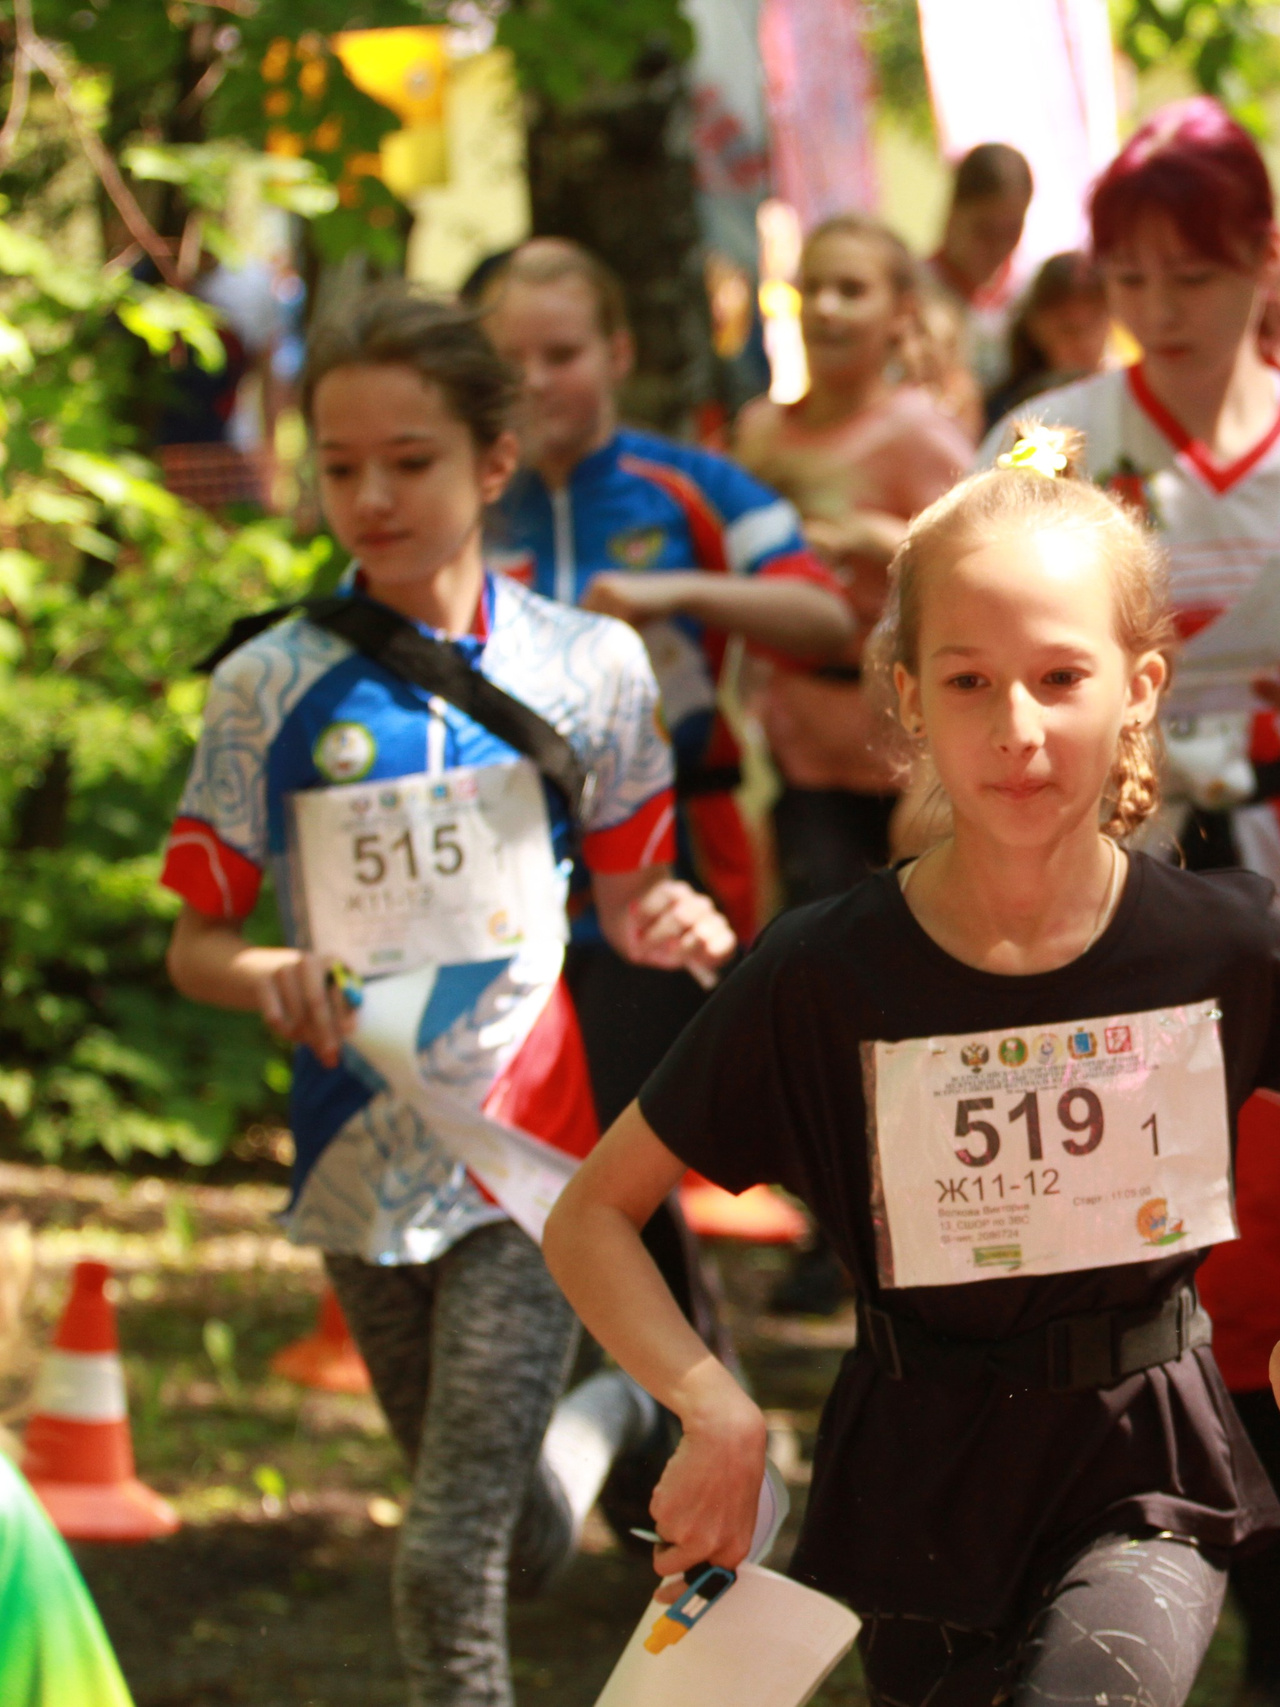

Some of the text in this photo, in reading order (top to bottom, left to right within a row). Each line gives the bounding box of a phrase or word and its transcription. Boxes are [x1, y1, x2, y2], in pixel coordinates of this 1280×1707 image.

[353, 823, 464, 885] 515
[954, 1087, 1160, 1168] 519 1
[935, 1168, 1061, 1204] Ж11-12
